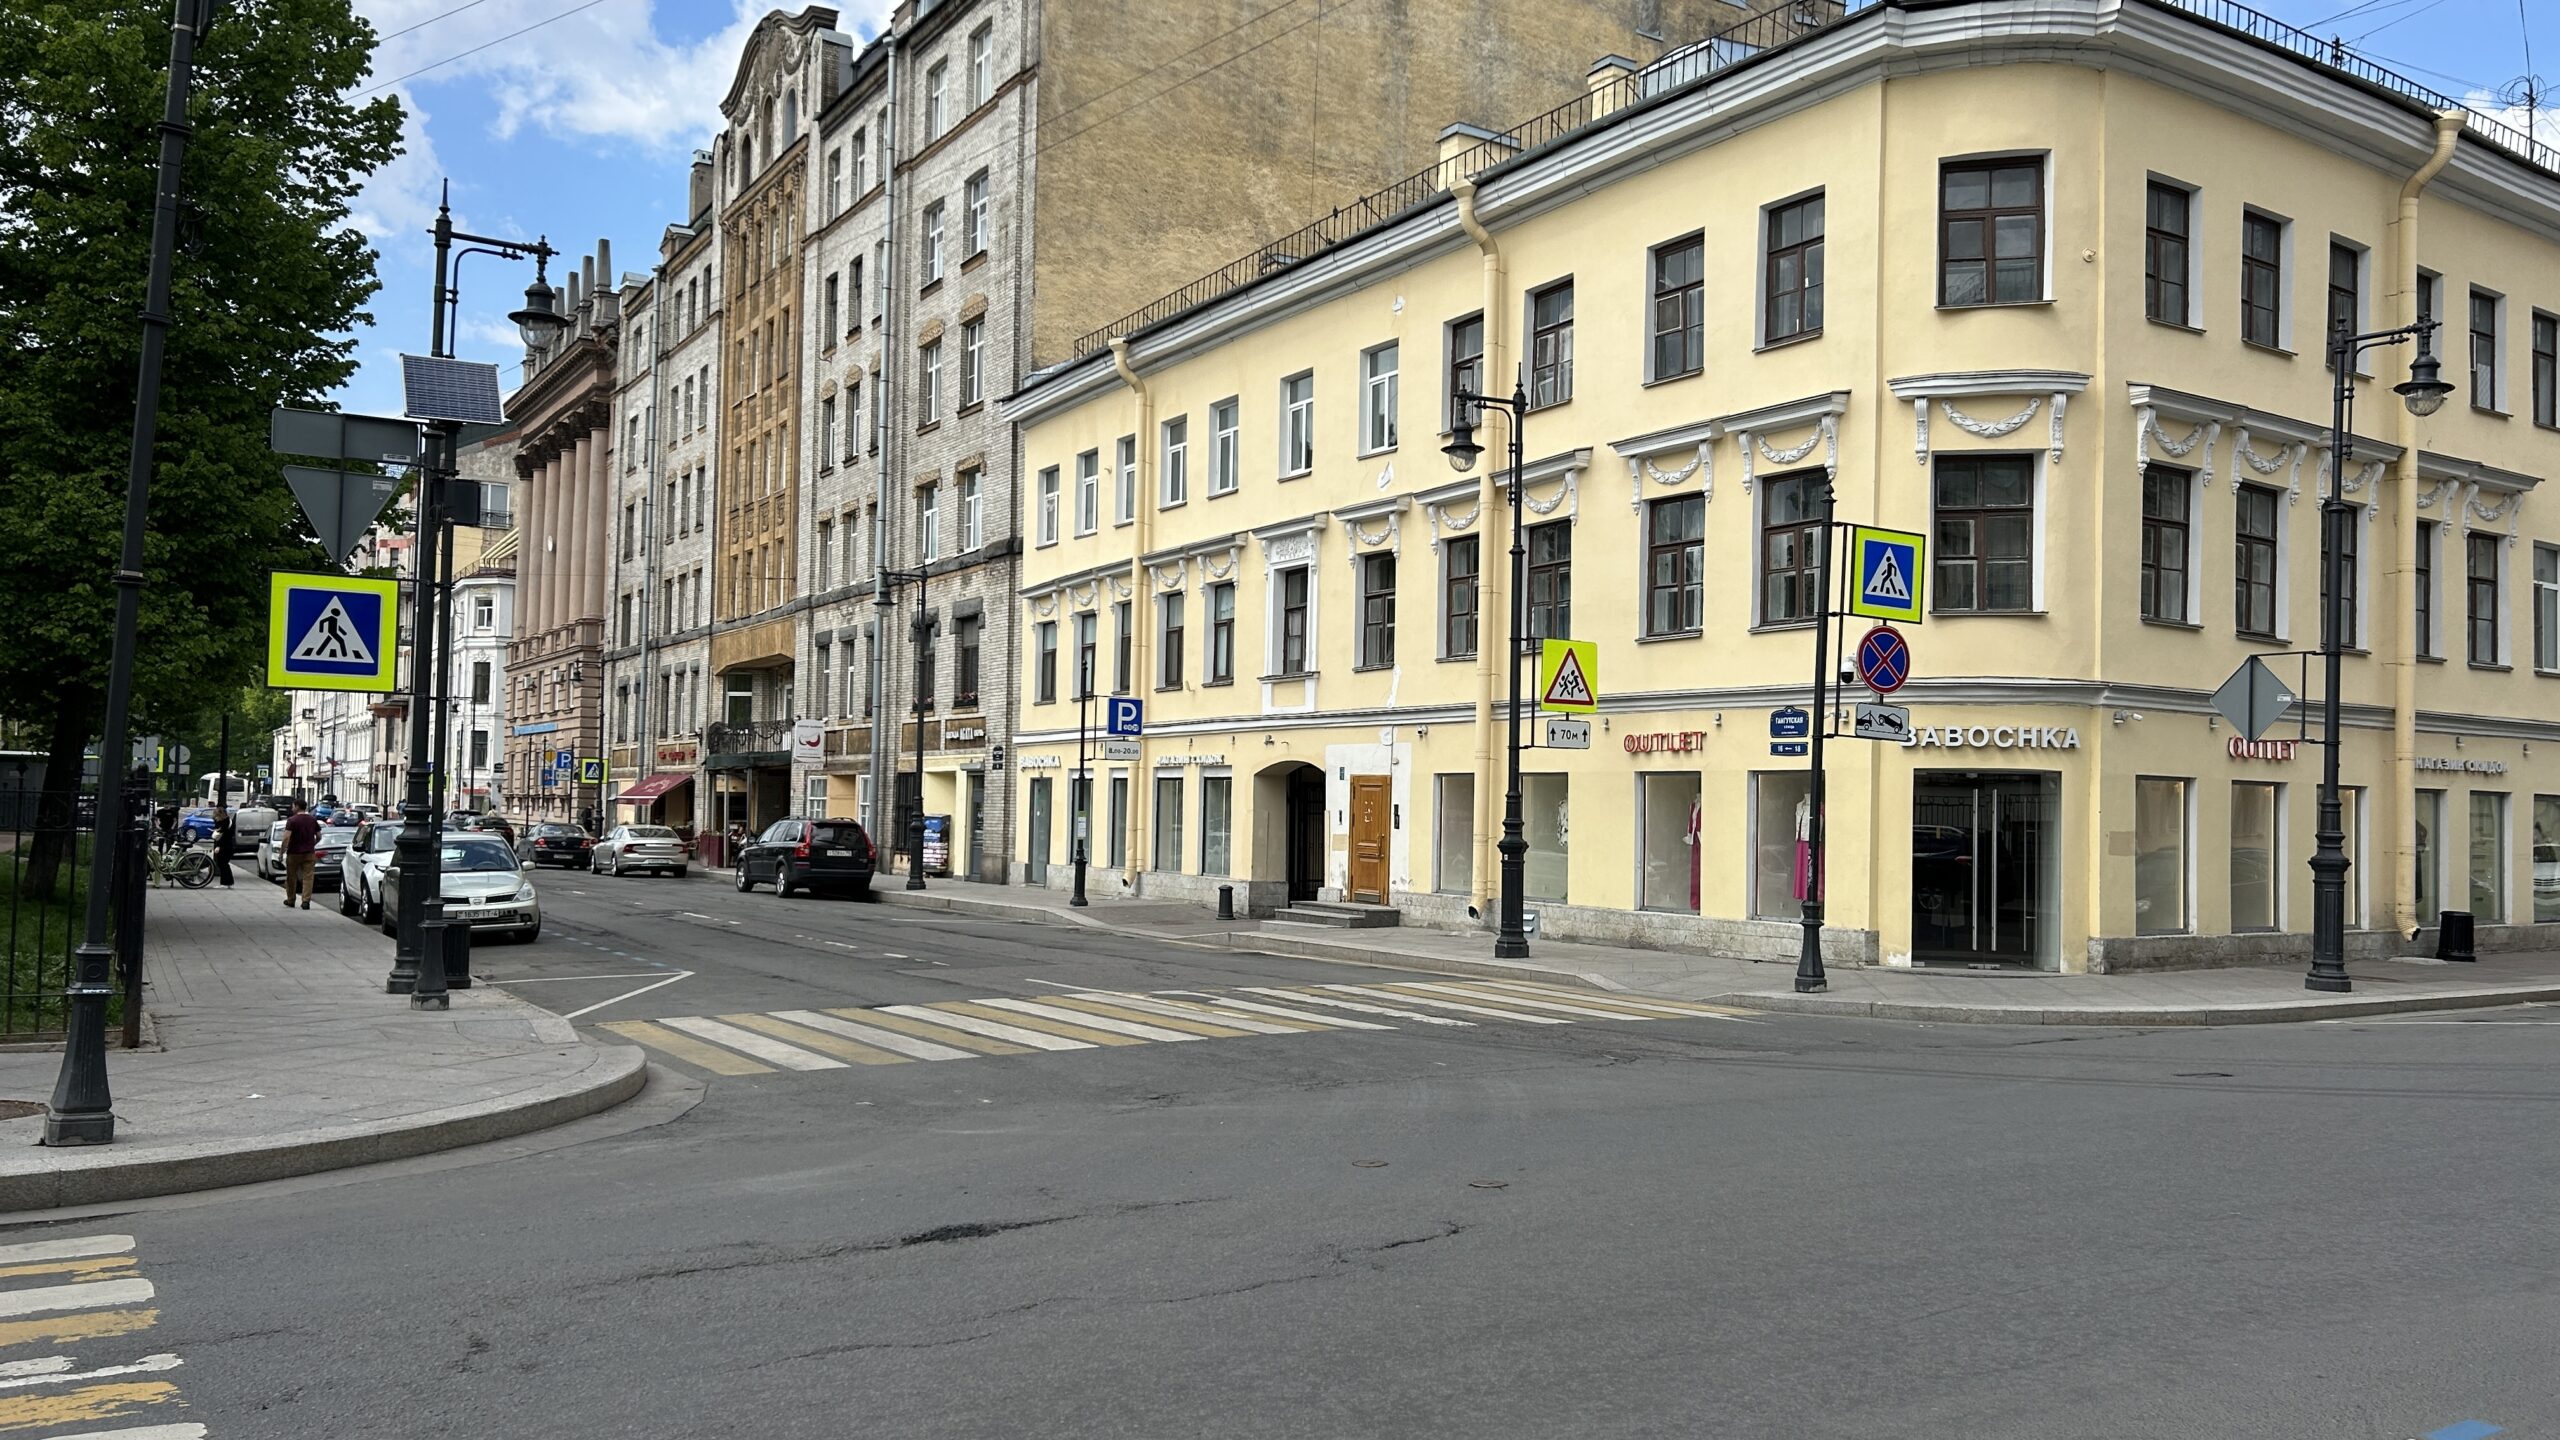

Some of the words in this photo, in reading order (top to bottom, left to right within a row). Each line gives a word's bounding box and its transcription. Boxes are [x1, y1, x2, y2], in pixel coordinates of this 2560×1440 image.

[1117, 702, 1137, 731] P
[1623, 731, 1707, 752] OUTLET
[1899, 725, 2081, 749] BABOCHKA
[2415, 757, 2465, 770] МАГАЗИН
